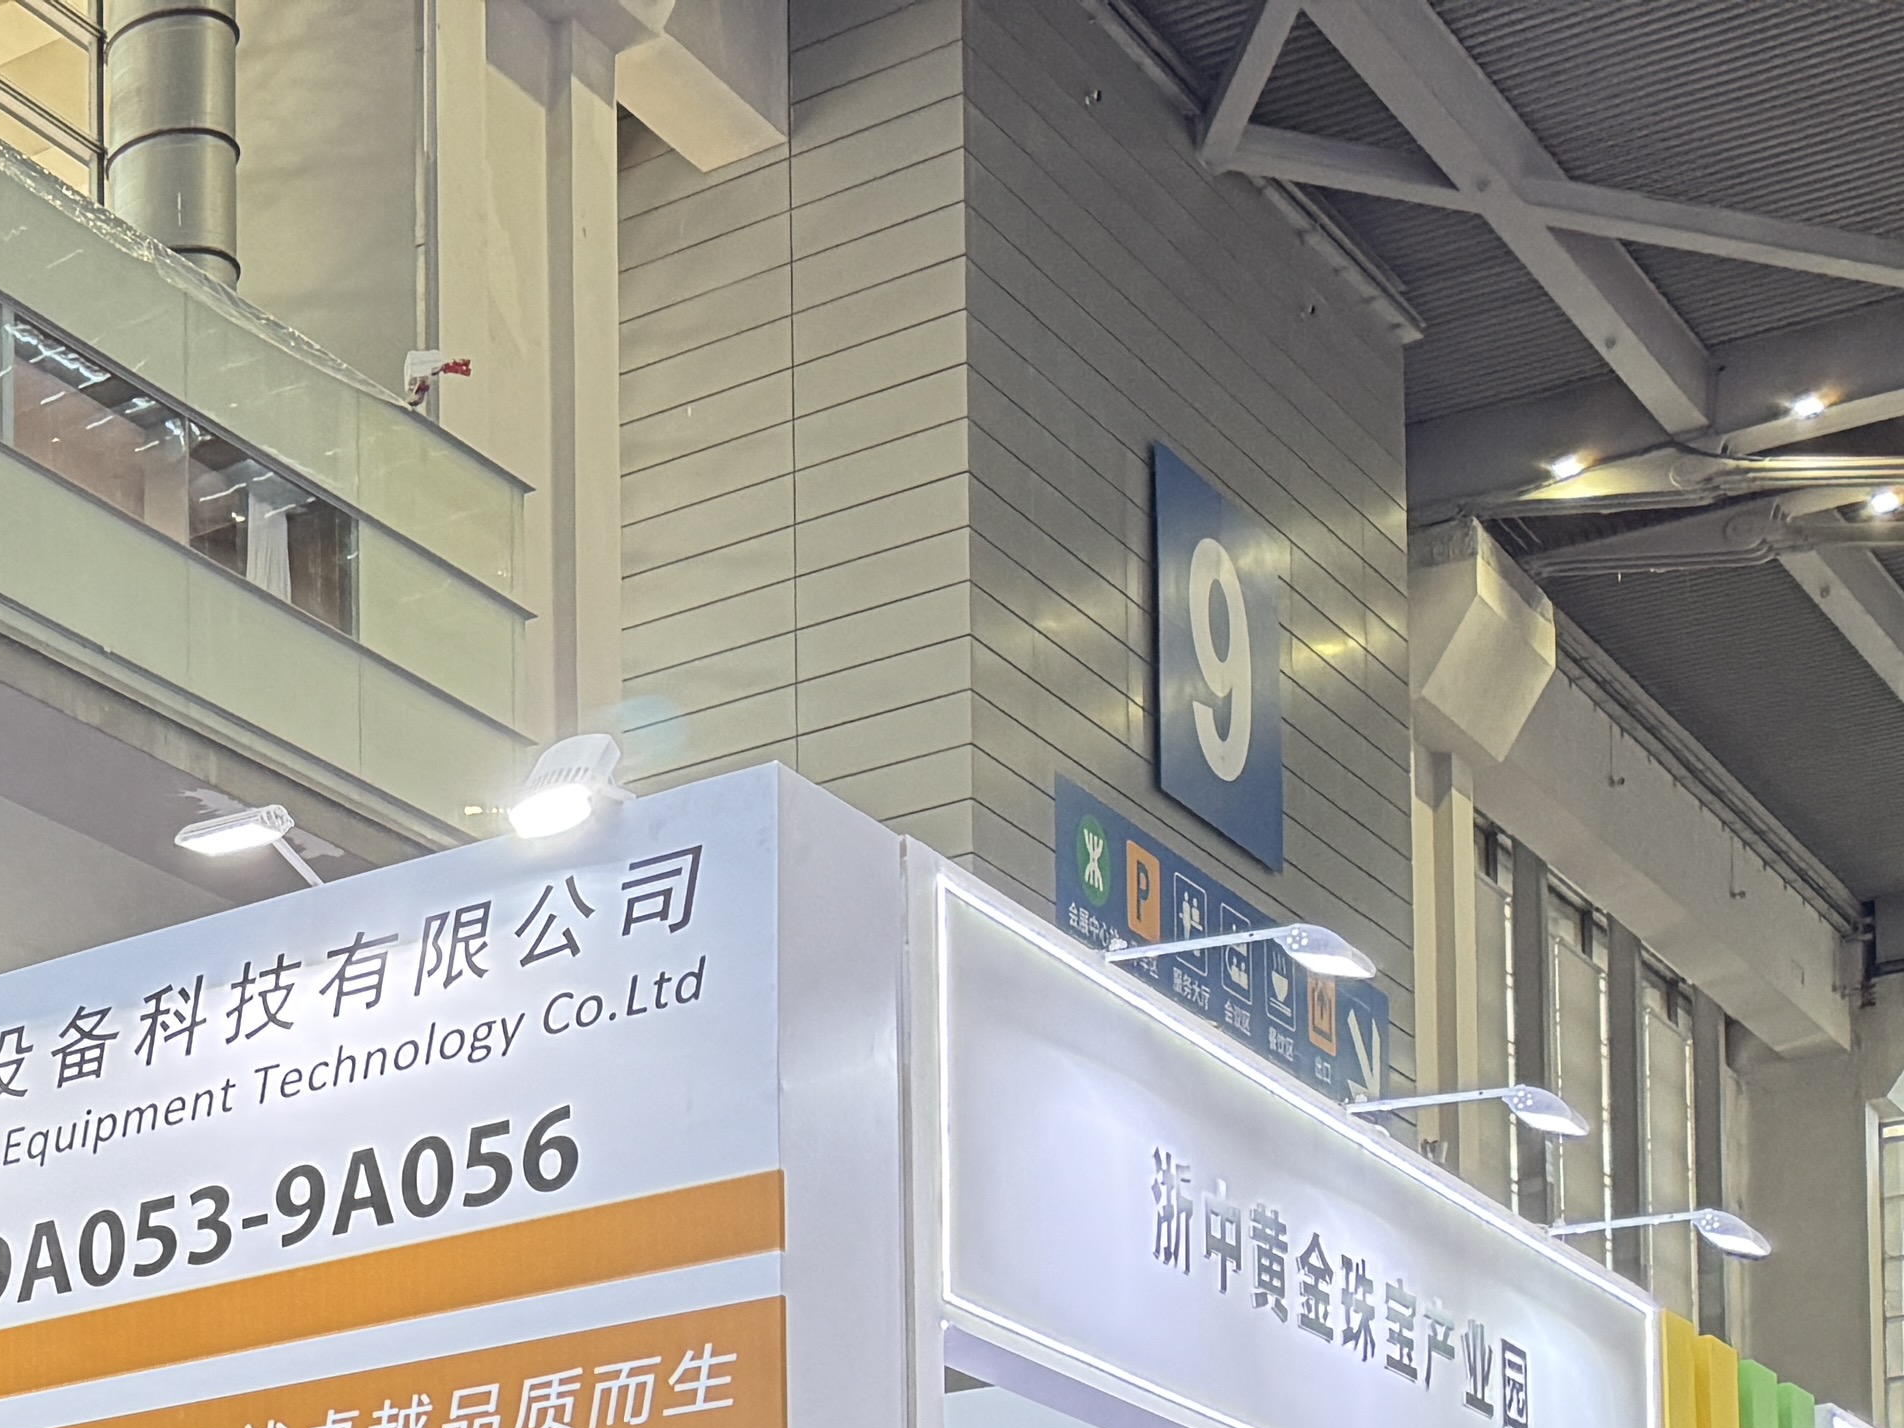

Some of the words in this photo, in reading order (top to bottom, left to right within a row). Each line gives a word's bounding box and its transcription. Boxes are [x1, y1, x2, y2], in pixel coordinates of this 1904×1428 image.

[1190, 537, 1253, 782] 9
[2, 1079, 235, 1170] Equipment
[256, 1008, 525, 1104] Technology
[544, 956, 704, 1038] Co.Ltd
[1224, 1000, 1252, 1037] 会议区
[1314, 1056, 1332, 1085] 出口
